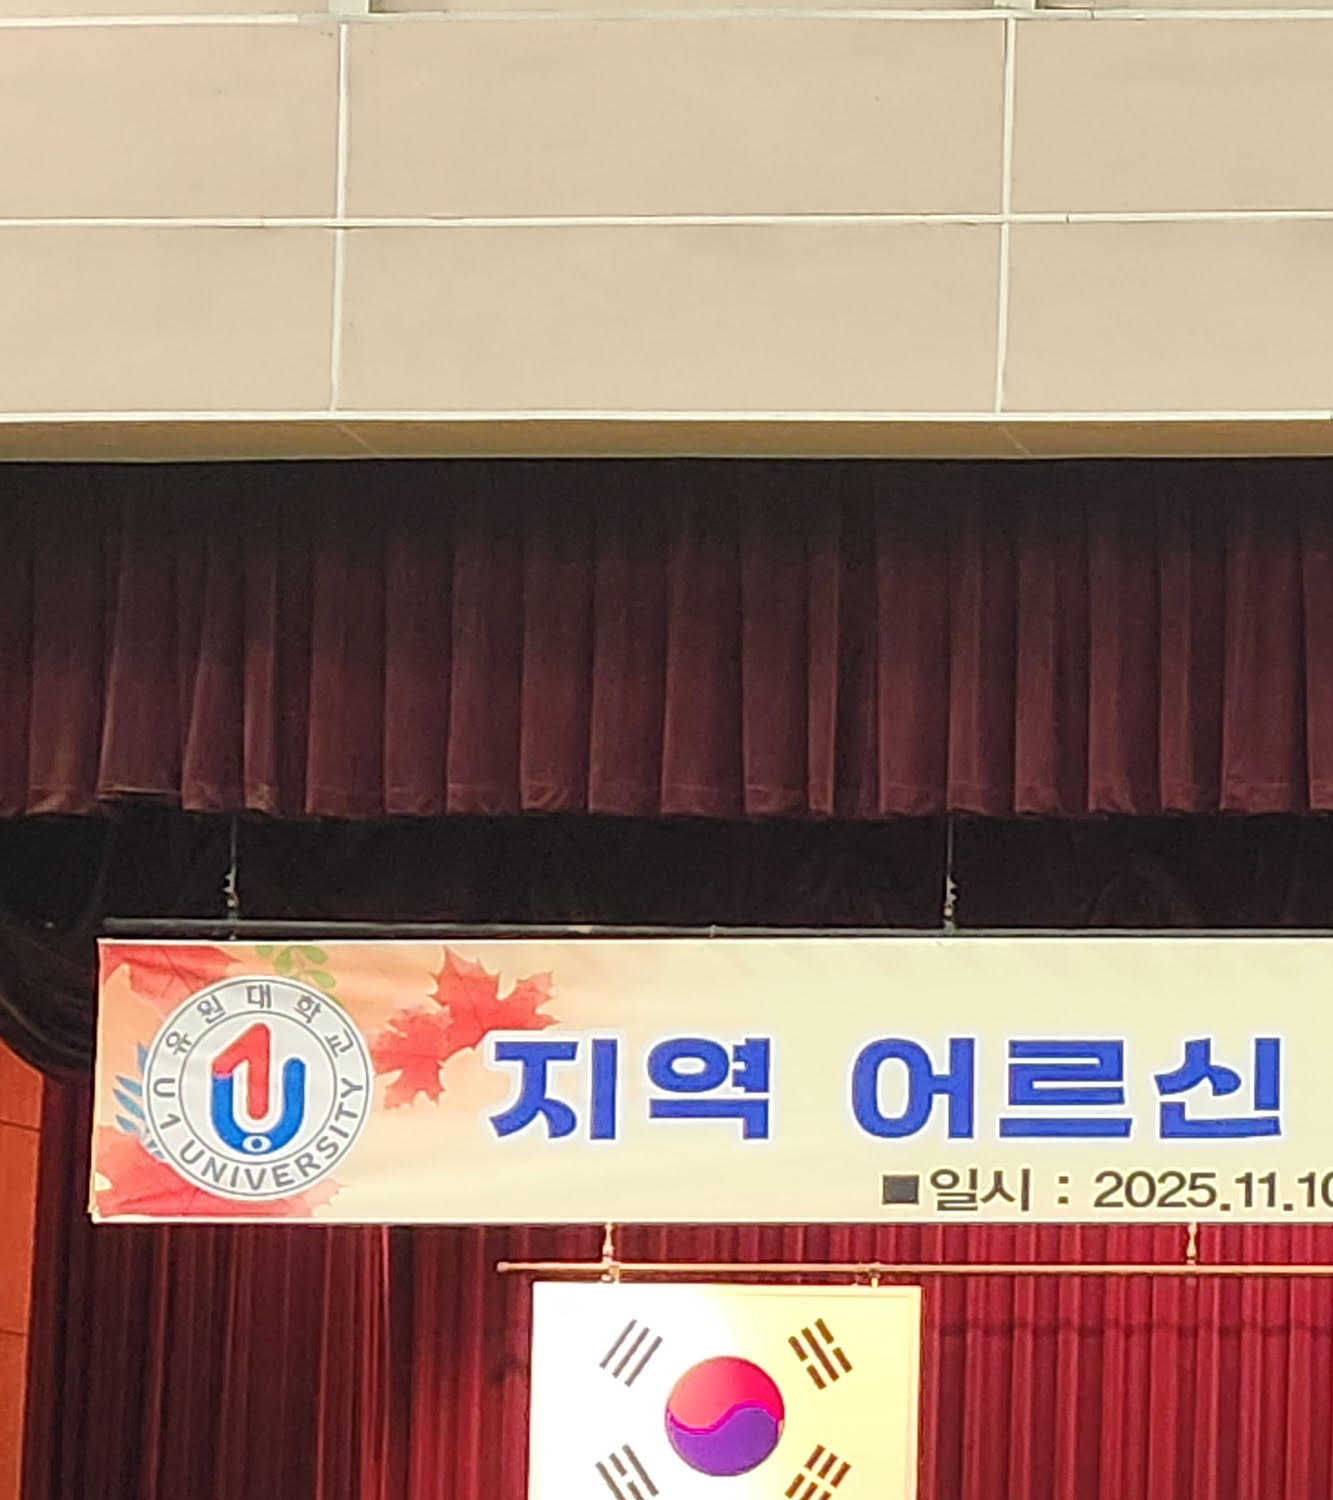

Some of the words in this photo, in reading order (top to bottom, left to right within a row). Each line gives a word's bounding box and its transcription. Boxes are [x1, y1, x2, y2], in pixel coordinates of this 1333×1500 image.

[165, 984, 354, 1058] 유원대학교
[490, 1036, 771, 1140] 지역
[852, 1038, 1281, 1139] 어르신
[179, 1076, 363, 1191] UNIVERSITY
[930, 1168, 1030, 1212] 일시
